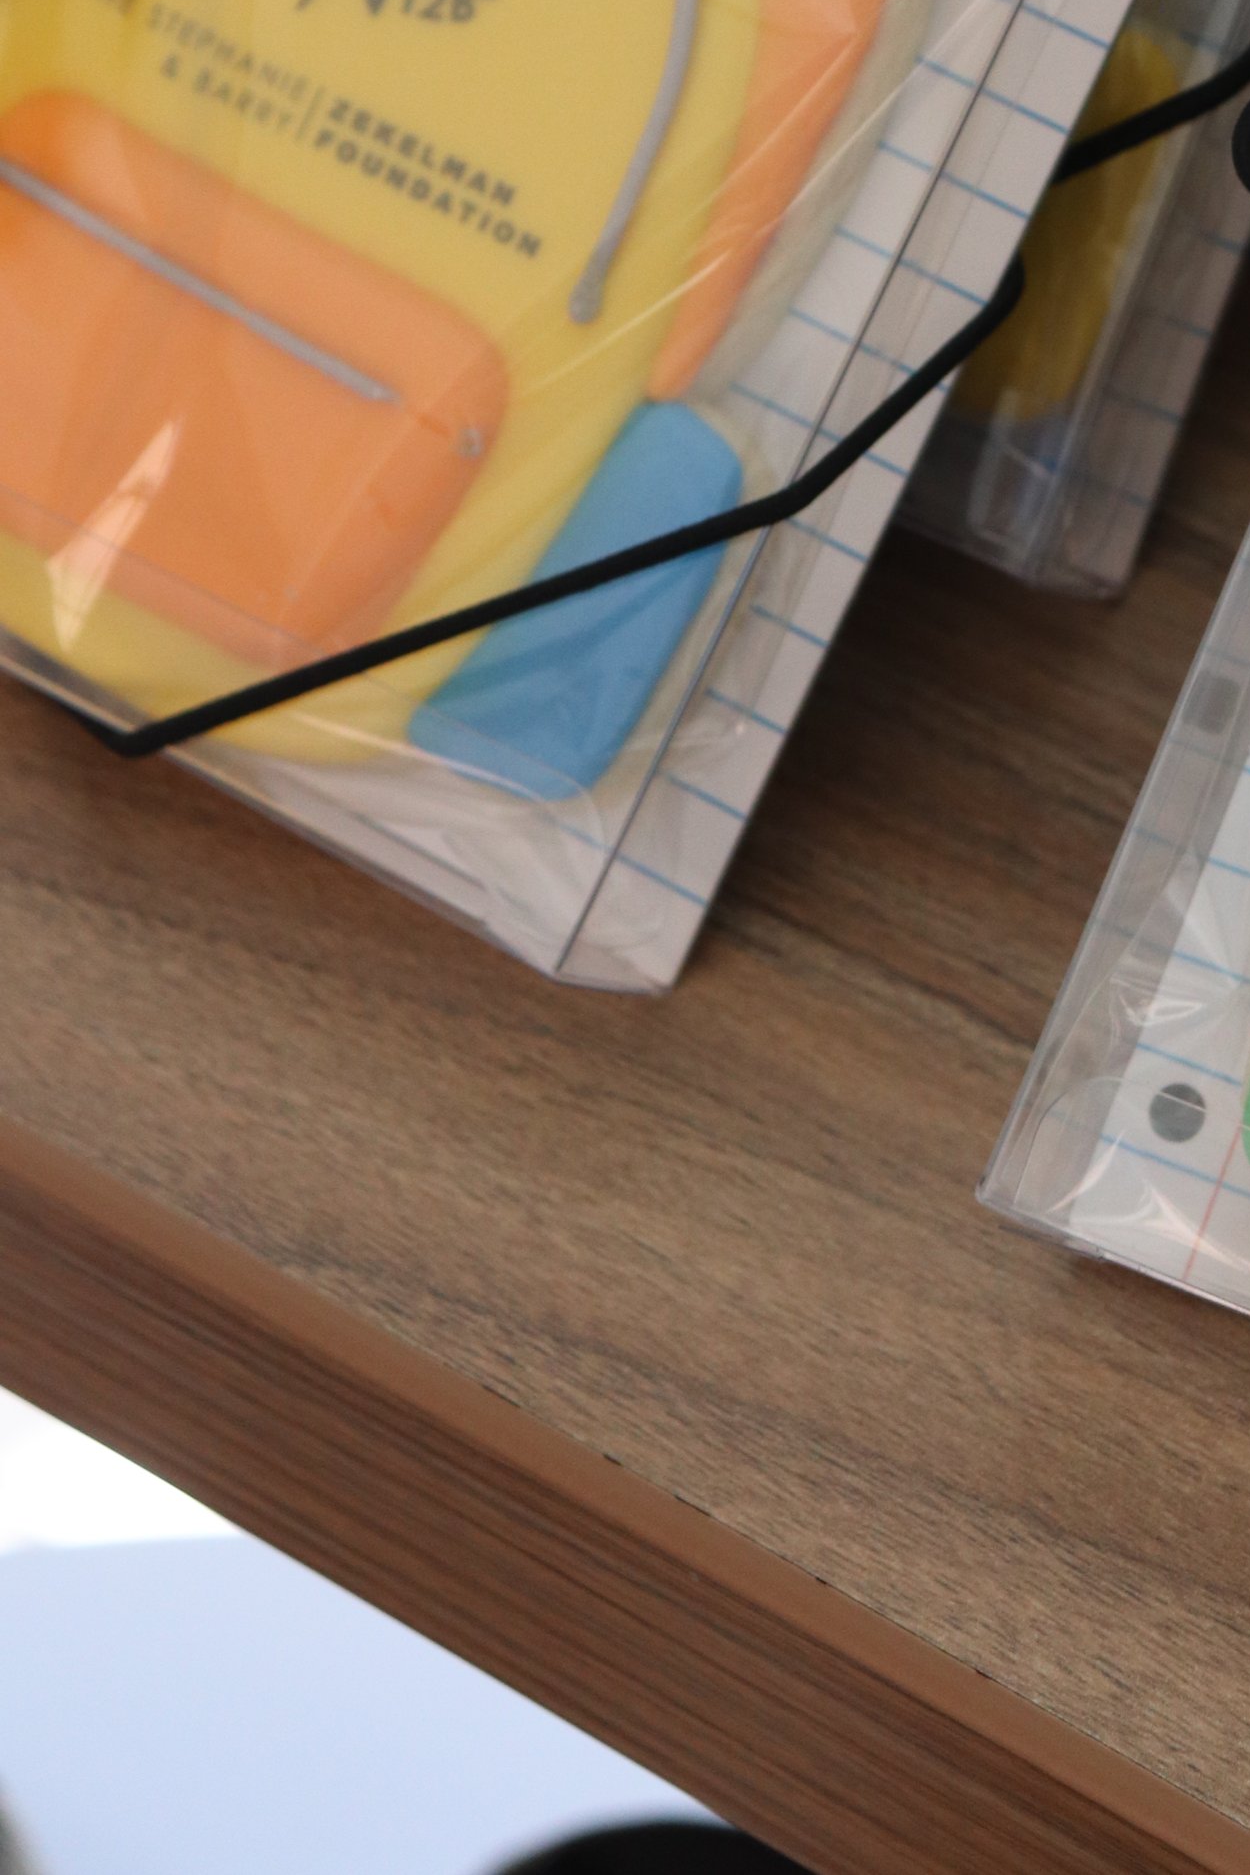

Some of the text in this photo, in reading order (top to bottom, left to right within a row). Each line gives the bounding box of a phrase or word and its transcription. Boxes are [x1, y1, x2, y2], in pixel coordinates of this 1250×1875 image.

[149, 3, 309, 103] STEPHANIE
[314, 128, 542, 258] FOUNDATION
[328, 98, 518, 206] ZEKELMAN
